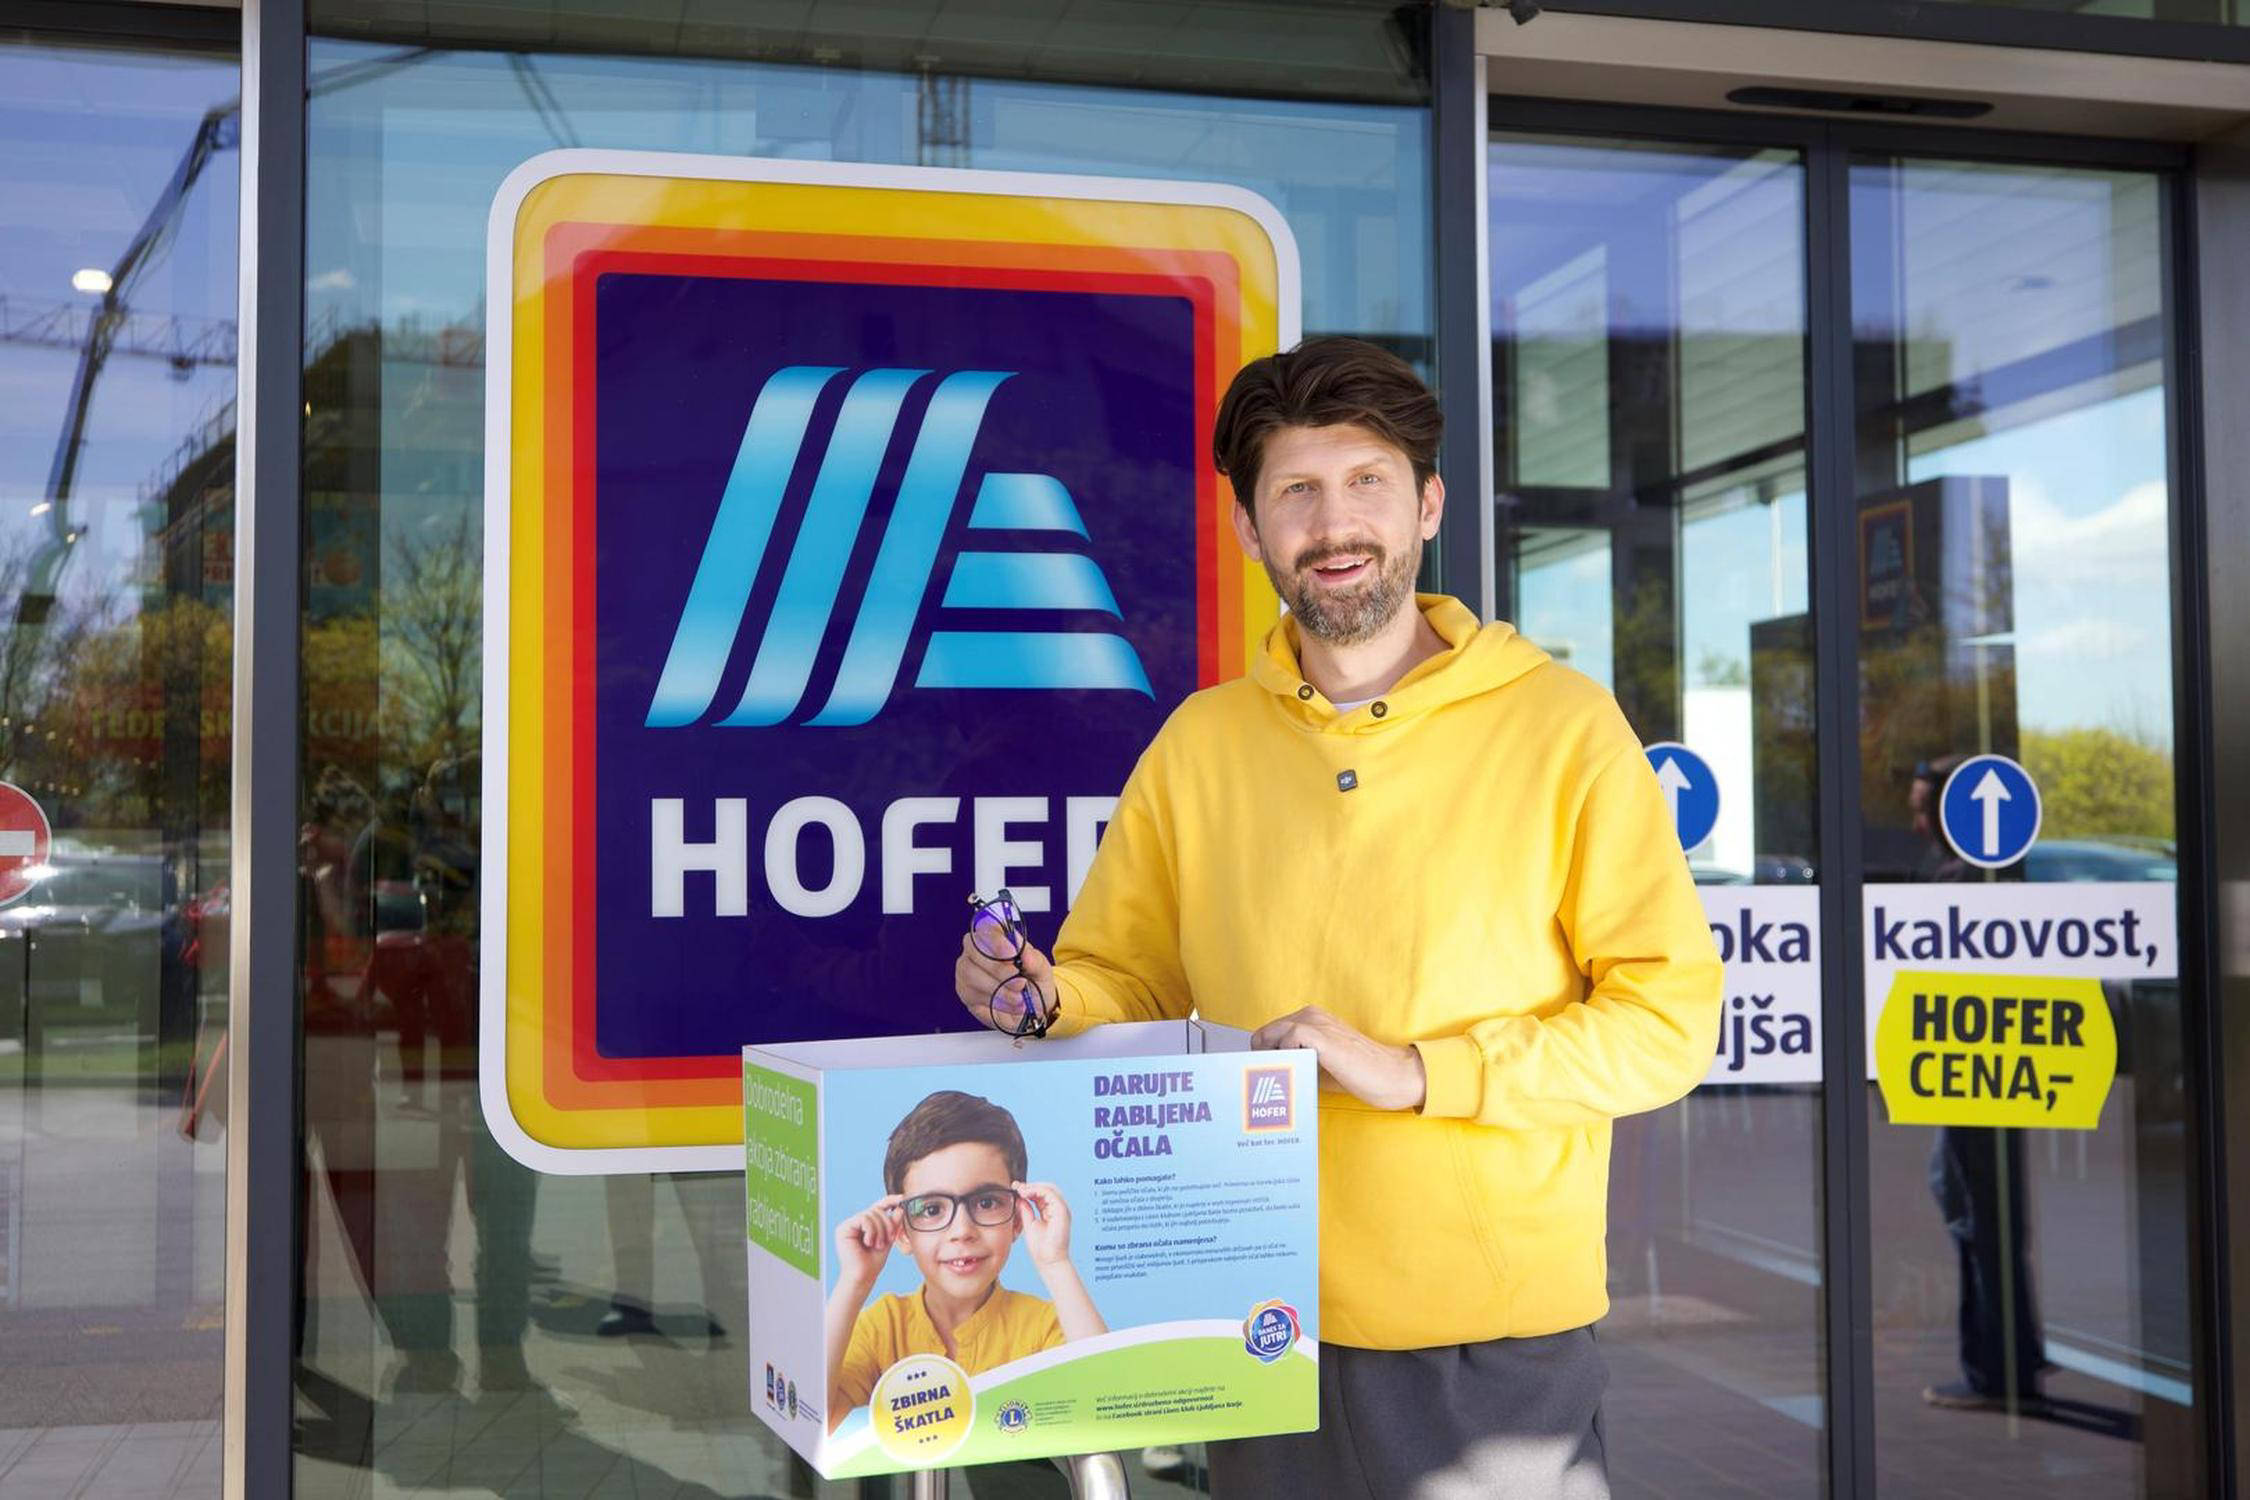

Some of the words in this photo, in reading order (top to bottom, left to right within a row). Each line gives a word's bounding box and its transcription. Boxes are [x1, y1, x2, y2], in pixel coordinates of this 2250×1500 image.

[1873, 905, 2158, 968] kakovost,
[1911, 993, 2085, 1047] HOFER
[1093, 1071, 1194, 1097] DARUJTE
[746, 1074, 804, 1127] Dobrodelna
[1252, 1106, 1287, 1118] HOFER
[1094, 1101, 1213, 1129] RABLJENA
[1093, 1129, 1173, 1160] OČALA
[747, 1136, 774, 1181] akcija
[774, 1145, 817, 1202] zbiranja
[1094, 1177, 1112, 1186] Kako
[1114, 1176, 1135, 1185] lahko
[750, 1193, 790, 1242] rabljenih
[1153, 1238, 1173, 1247] očala
[1260, 1330, 1287, 1348] JUTRI
[891, 1384, 951, 1412] ZBIRNA
[894, 1406, 955, 1434] ŠKATLA
